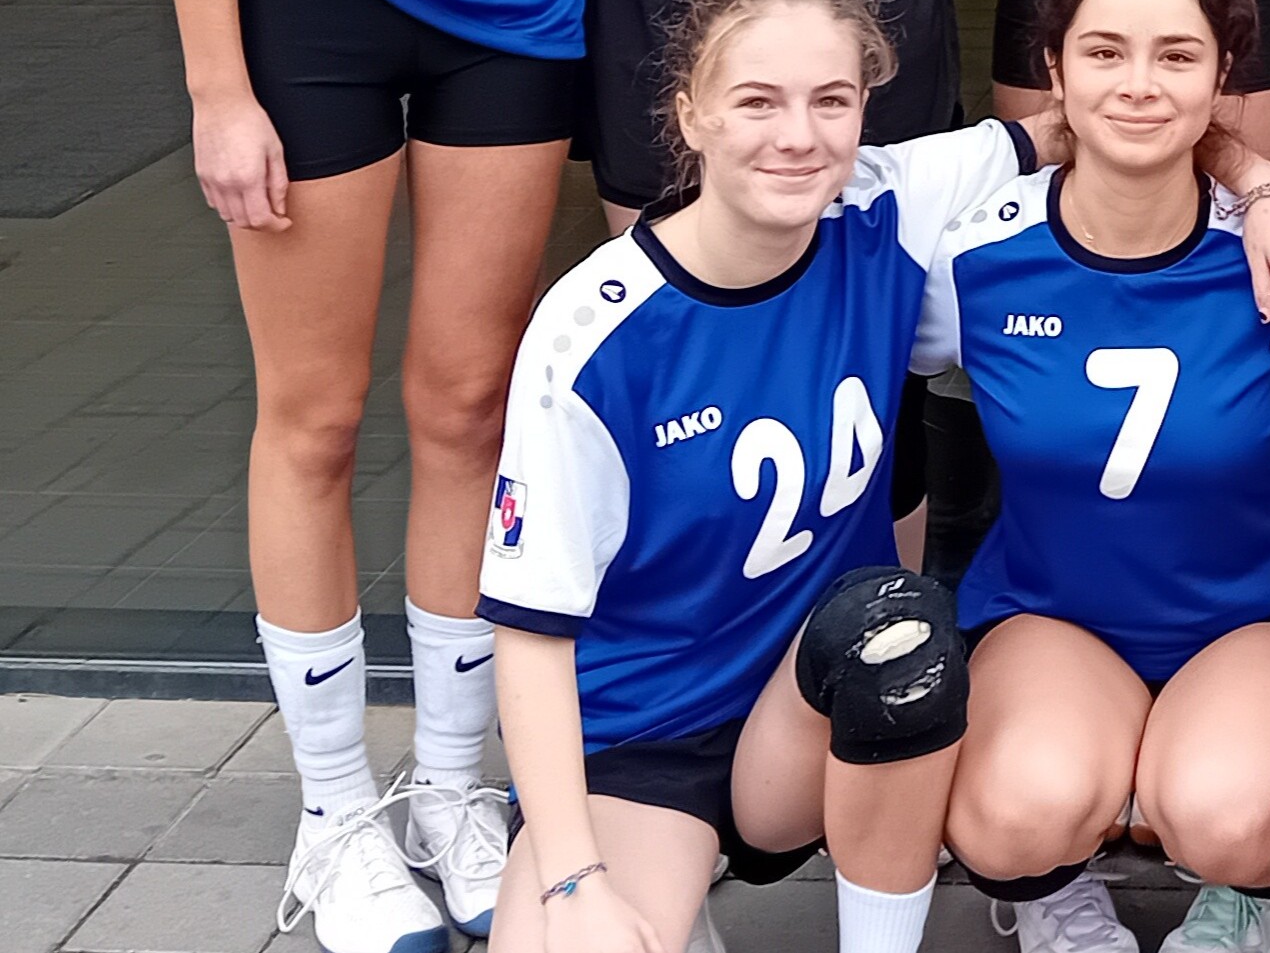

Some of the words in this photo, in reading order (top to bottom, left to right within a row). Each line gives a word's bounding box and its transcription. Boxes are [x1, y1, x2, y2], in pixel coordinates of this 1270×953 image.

[1003, 314, 1063, 338] JAKO
[654, 405, 723, 448] JAKO
[1085, 347, 1179, 500] 7
[731, 376, 885, 580] 24
